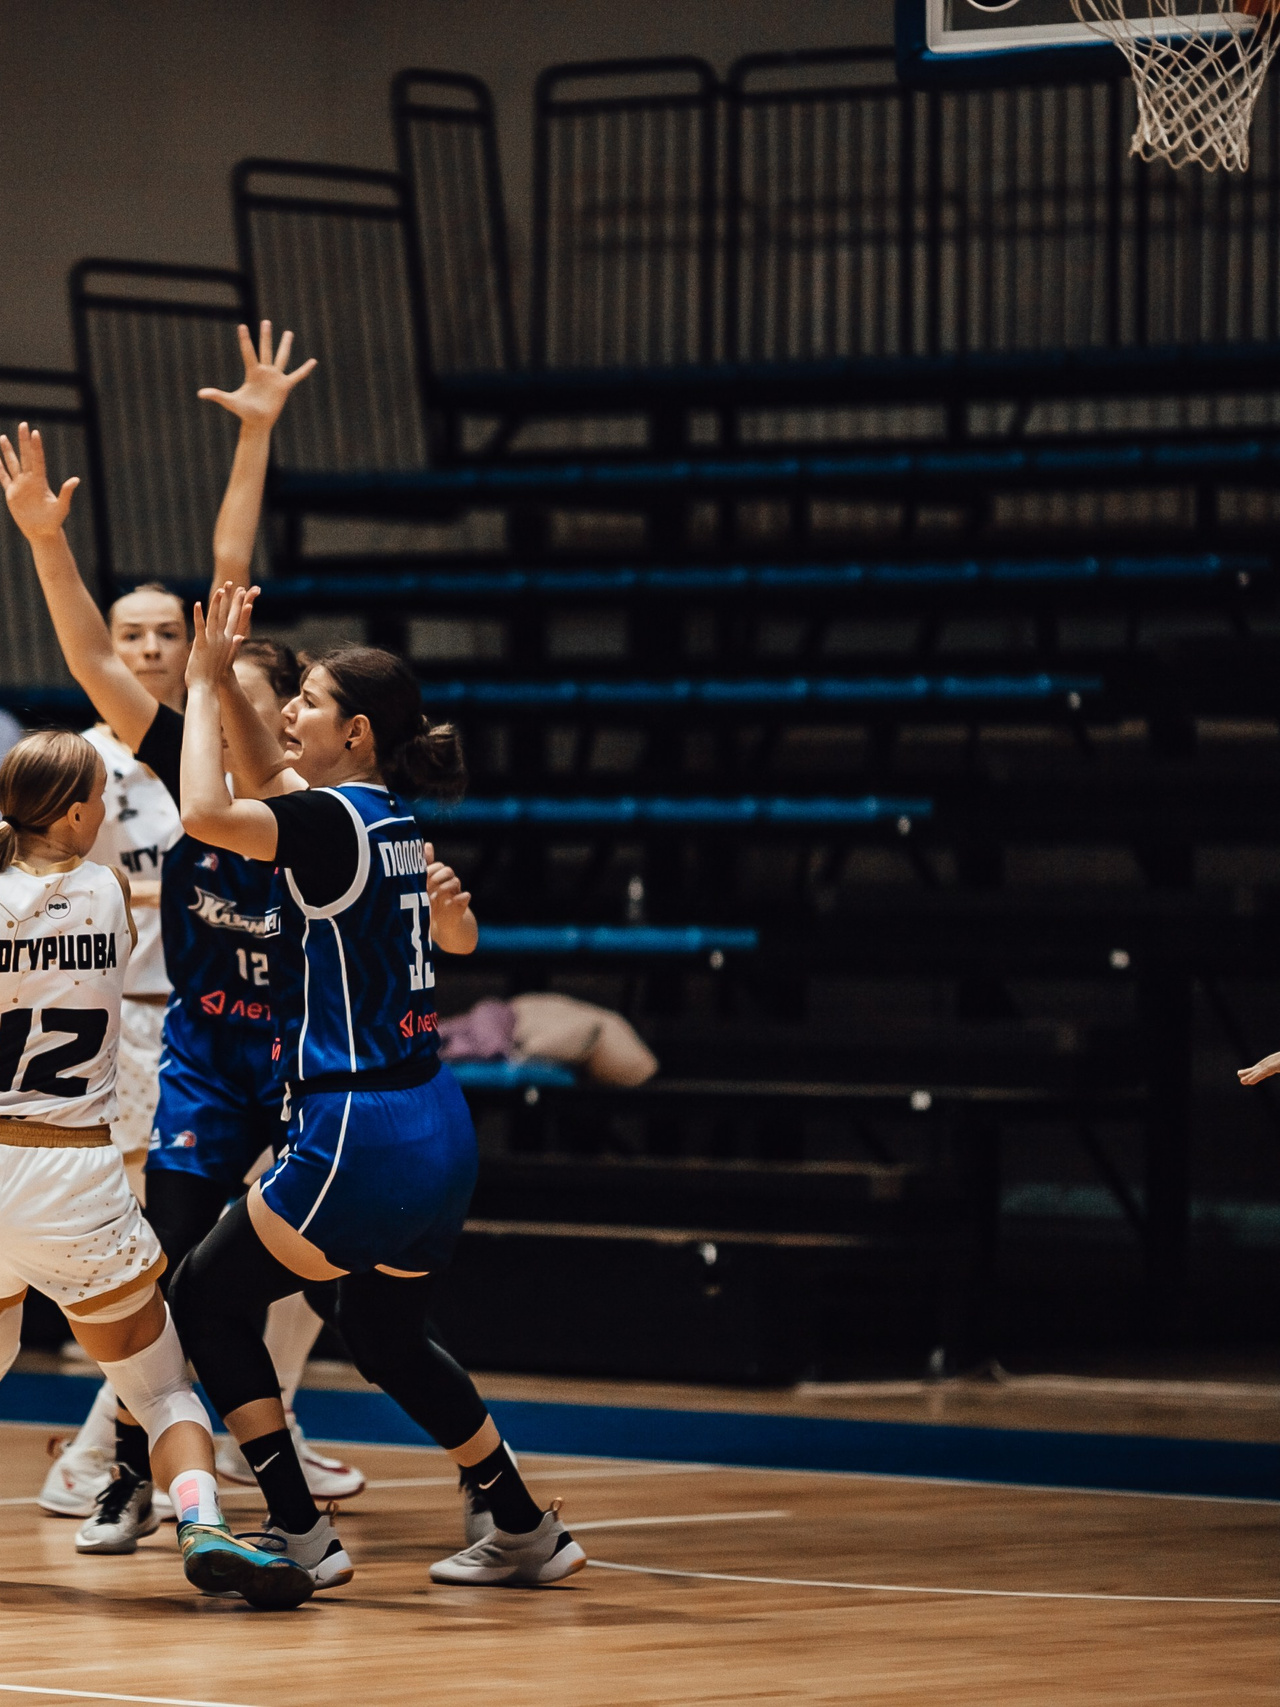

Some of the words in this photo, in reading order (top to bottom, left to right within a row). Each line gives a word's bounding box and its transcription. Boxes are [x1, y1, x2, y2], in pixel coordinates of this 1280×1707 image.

[378, 838, 427, 877] ПОПОВ
[48, 902, 68, 912] РФБ
[236, 948, 269, 986] 12
[231, 1000, 271, 1021] лет
